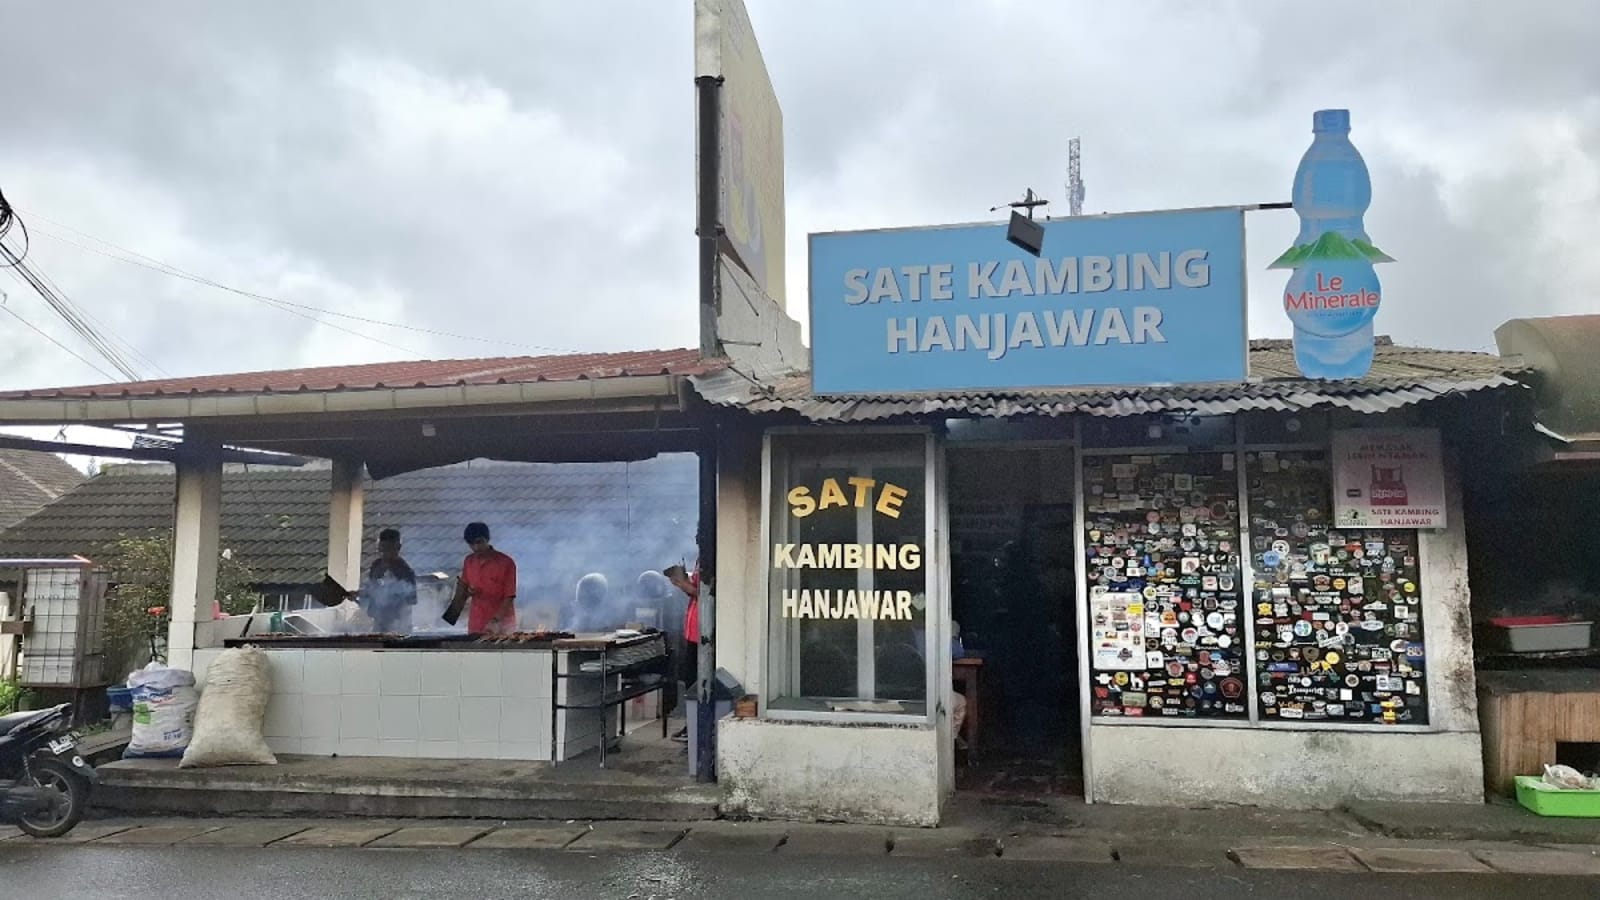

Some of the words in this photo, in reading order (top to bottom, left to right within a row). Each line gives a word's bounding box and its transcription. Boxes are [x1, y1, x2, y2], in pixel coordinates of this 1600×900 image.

[843, 263, 955, 306] SATE
[968, 248, 1211, 299] KAMBING
[1316, 272, 1343, 292] Le
[1285, 288, 1379, 312] Minerale
[886, 305, 1168, 361] HANJAWAR
[787, 476, 909, 519] SATE
[1371, 508, 1392, 516] SATE
[1394, 508, 1439, 516] KAMBING
[1380, 518, 1432, 526] HANJAWAR
[774, 543, 921, 570] KAMBING
[782, 588, 913, 621] HANJAWAR
